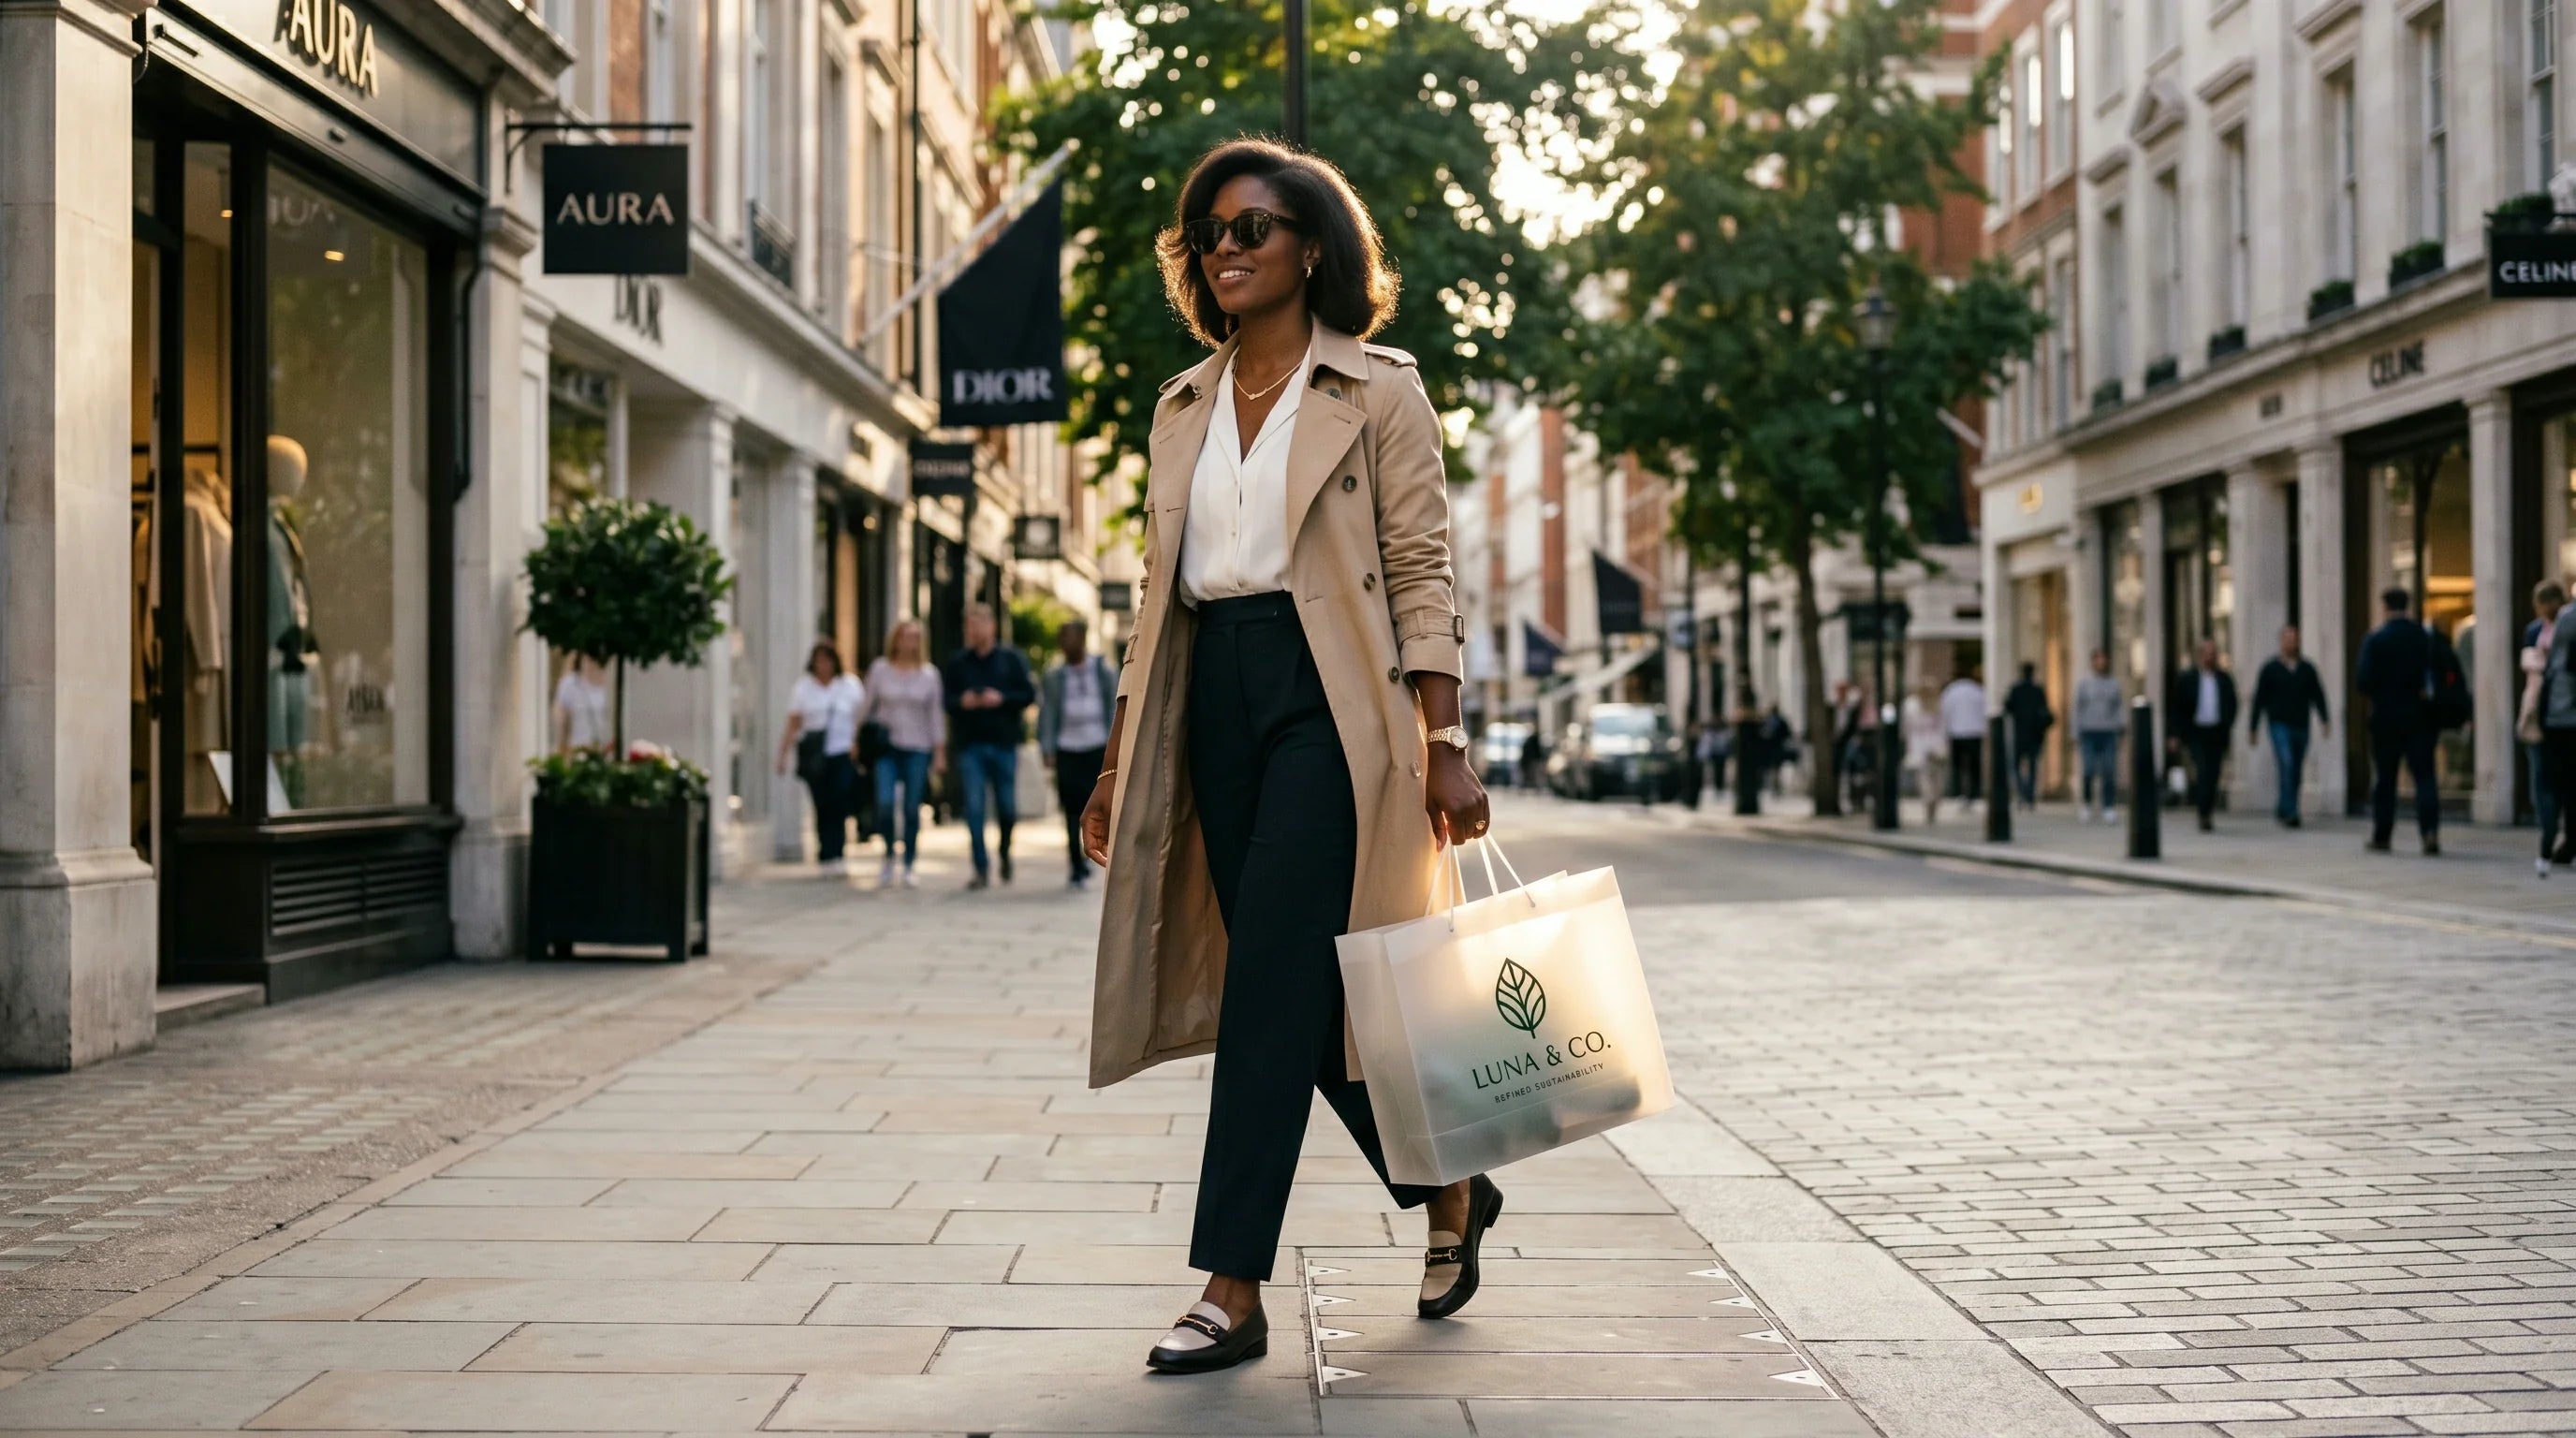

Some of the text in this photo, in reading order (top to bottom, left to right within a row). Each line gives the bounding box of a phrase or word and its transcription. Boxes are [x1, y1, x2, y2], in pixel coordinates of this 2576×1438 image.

[288, 0, 379, 98] AURA
[556, 192, 675, 226] AURA
[953, 367, 1054, 404] DIOR
[1471, 1031, 1612, 1090] LUNA & CO.
[1494, 1085, 1532, 1104] REFINED
